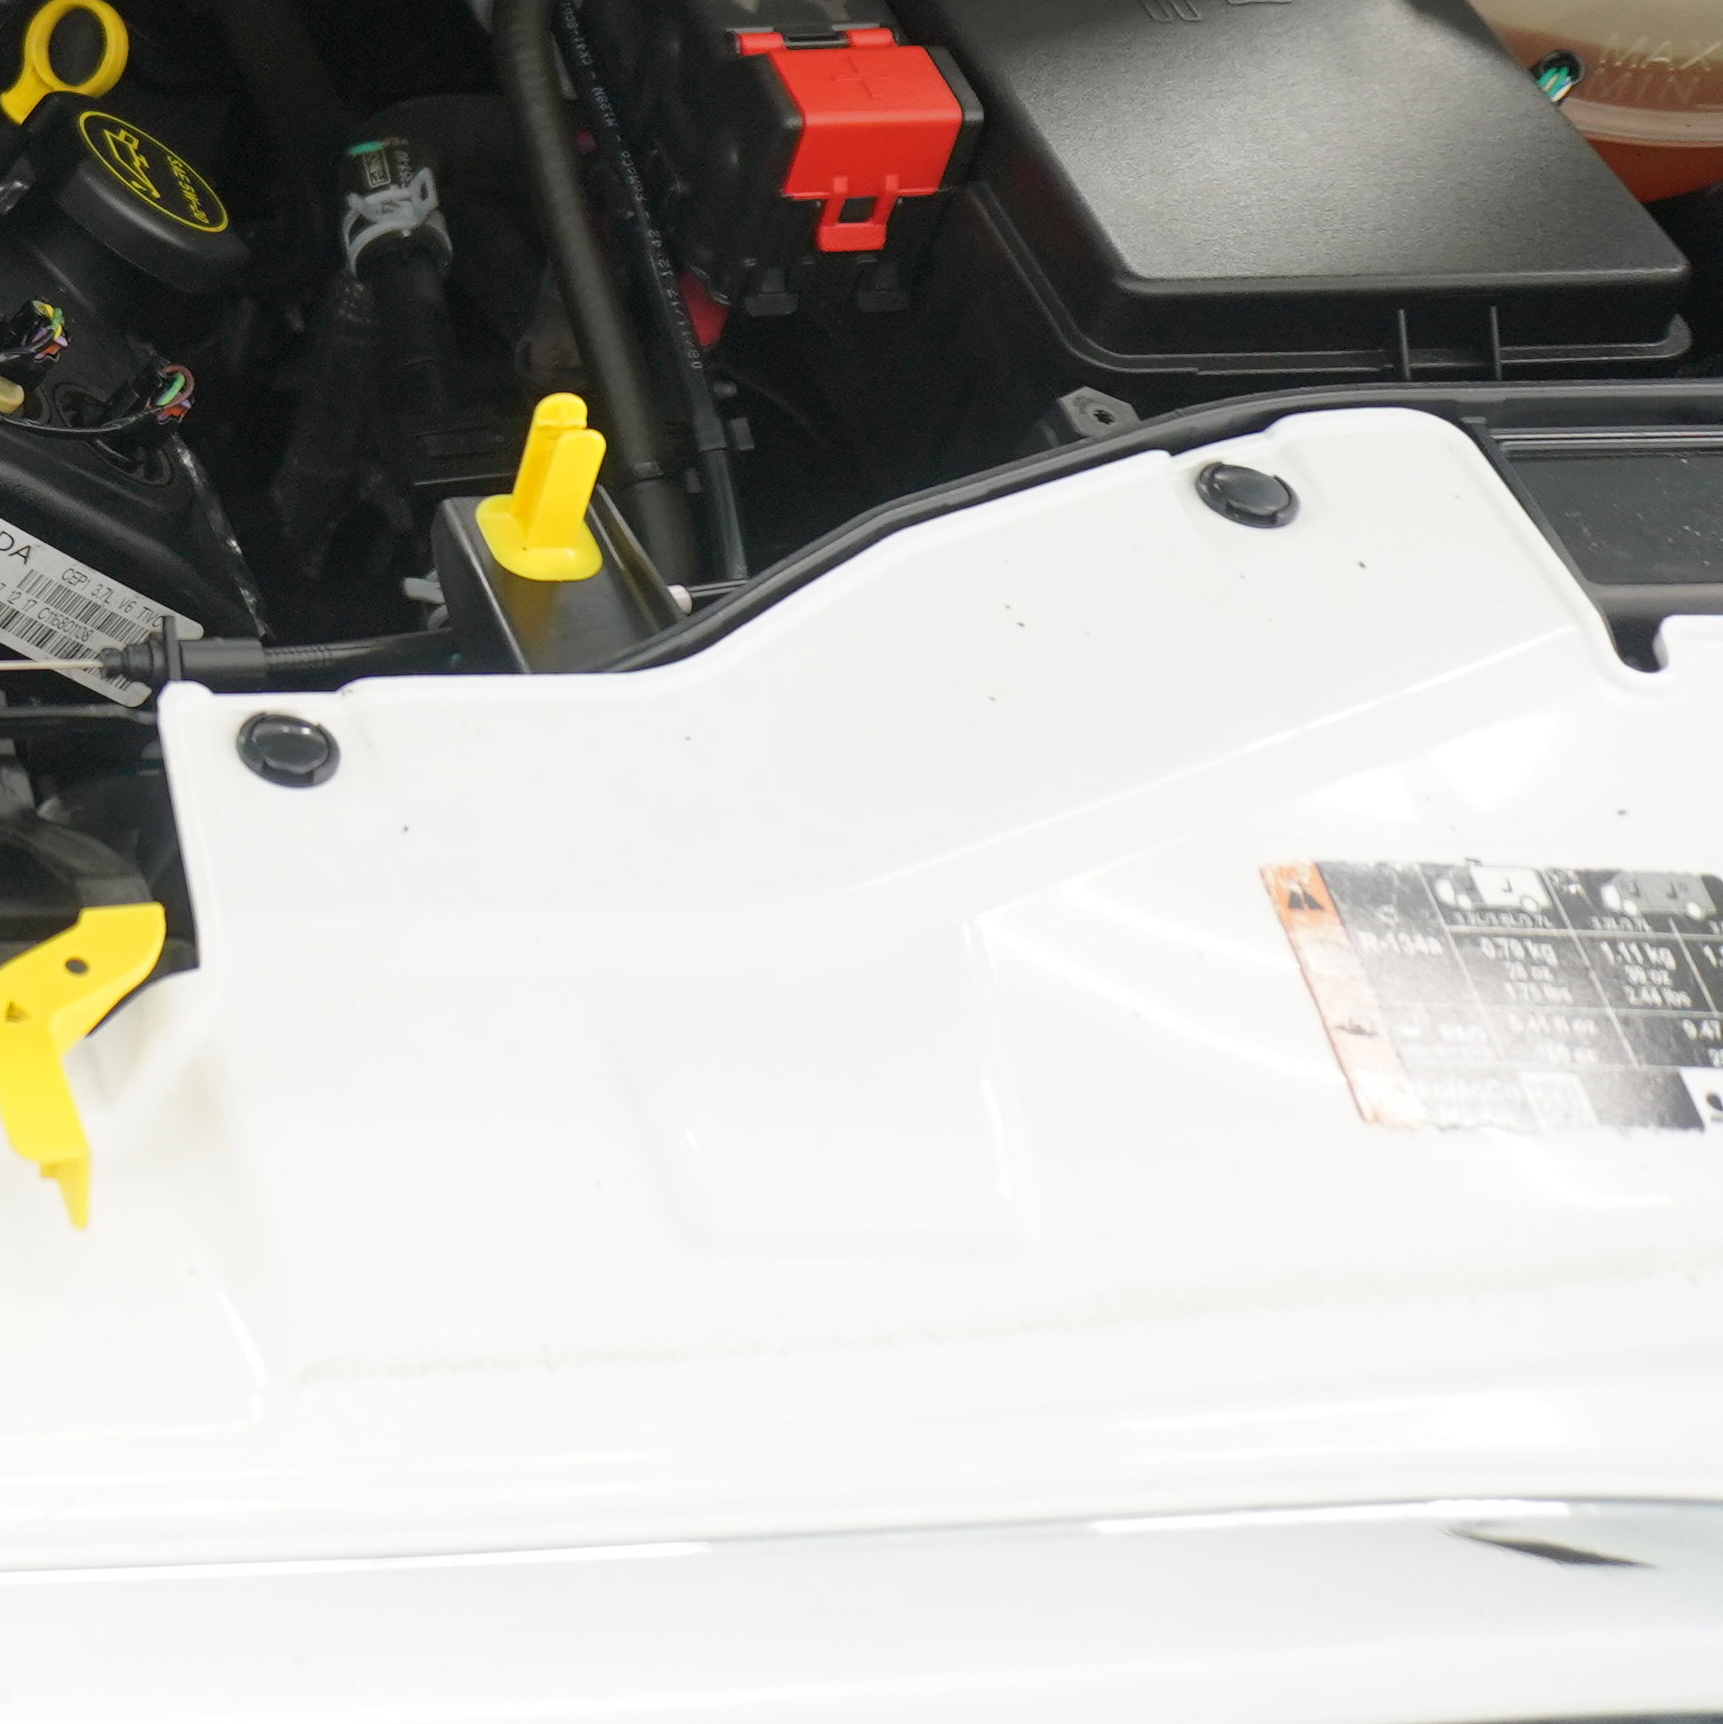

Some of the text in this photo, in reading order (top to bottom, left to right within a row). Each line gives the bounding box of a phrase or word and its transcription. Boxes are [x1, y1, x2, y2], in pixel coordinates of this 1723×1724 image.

[7, 590, 22, 605] 12
[24, 598, 38, 612] 17
[118, 596, 137, 613] V6
[1356, 931, 1444, 957] R-134a
[1524, 938, 1559, 967] kg
[1642, 941, 1676, 971] kg
